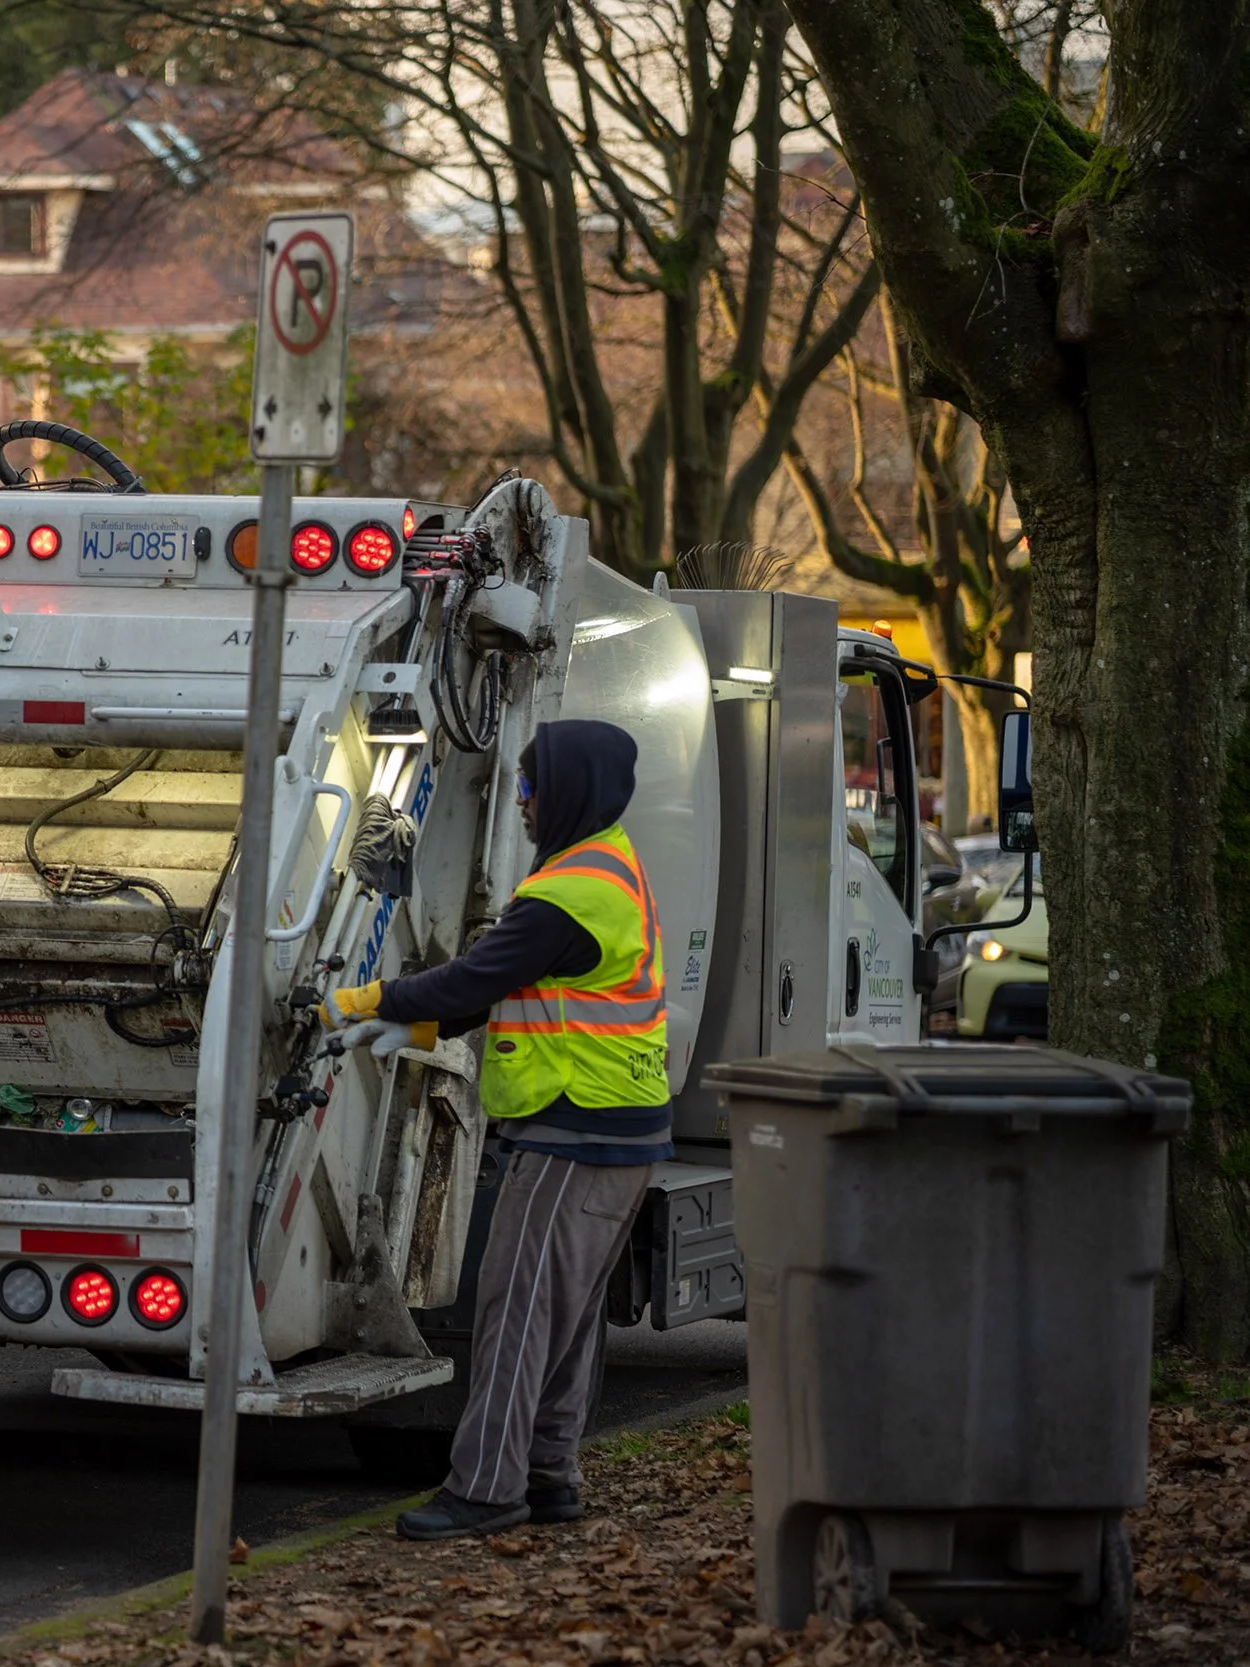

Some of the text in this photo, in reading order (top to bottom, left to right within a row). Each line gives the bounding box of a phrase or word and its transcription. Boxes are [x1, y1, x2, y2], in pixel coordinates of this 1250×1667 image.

[90, 521, 188, 531] Beautiful British Columbia
[868, 978, 903, 999] VANCOUVER
[869, 1012, 888, 1028] Engineering
